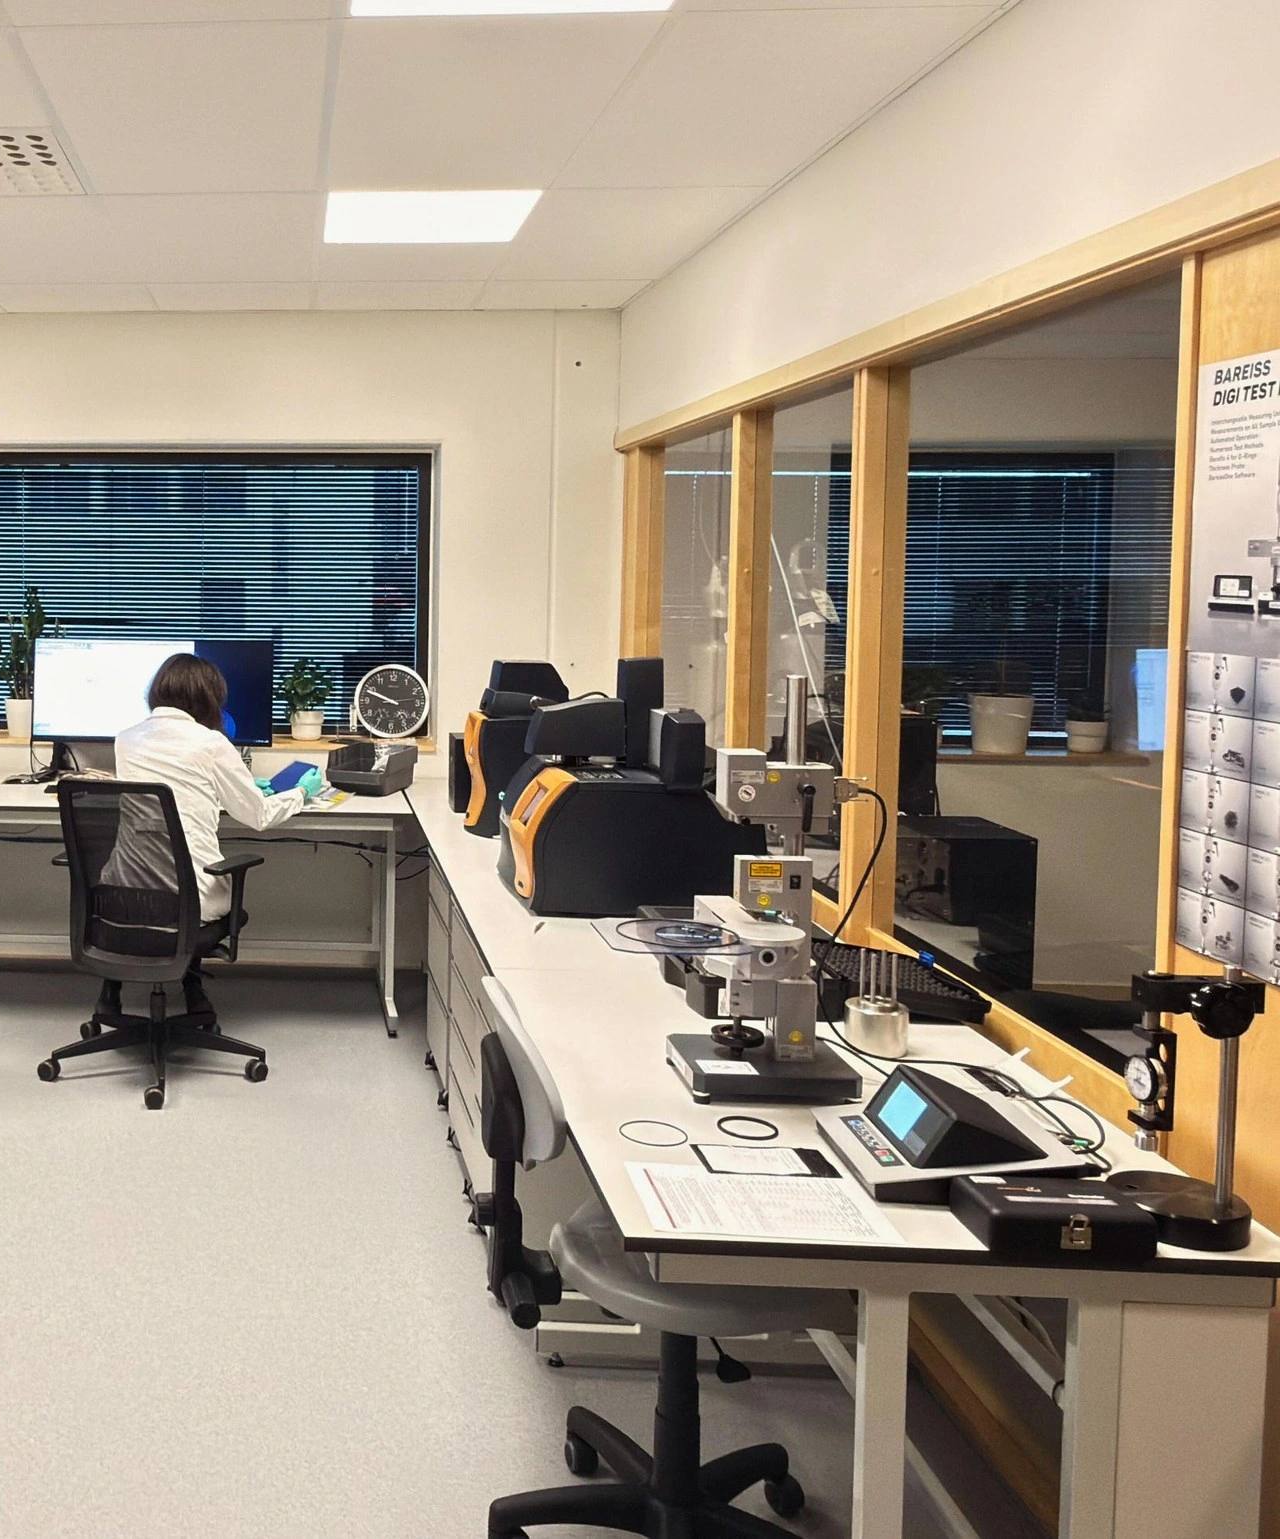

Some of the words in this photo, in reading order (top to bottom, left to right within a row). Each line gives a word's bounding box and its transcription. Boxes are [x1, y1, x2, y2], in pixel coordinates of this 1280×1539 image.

[1214, 360, 1271, 385] BAREISS
[1213, 388, 1240, 406] DIGI
[1243, 380, 1277, 402] TEST
